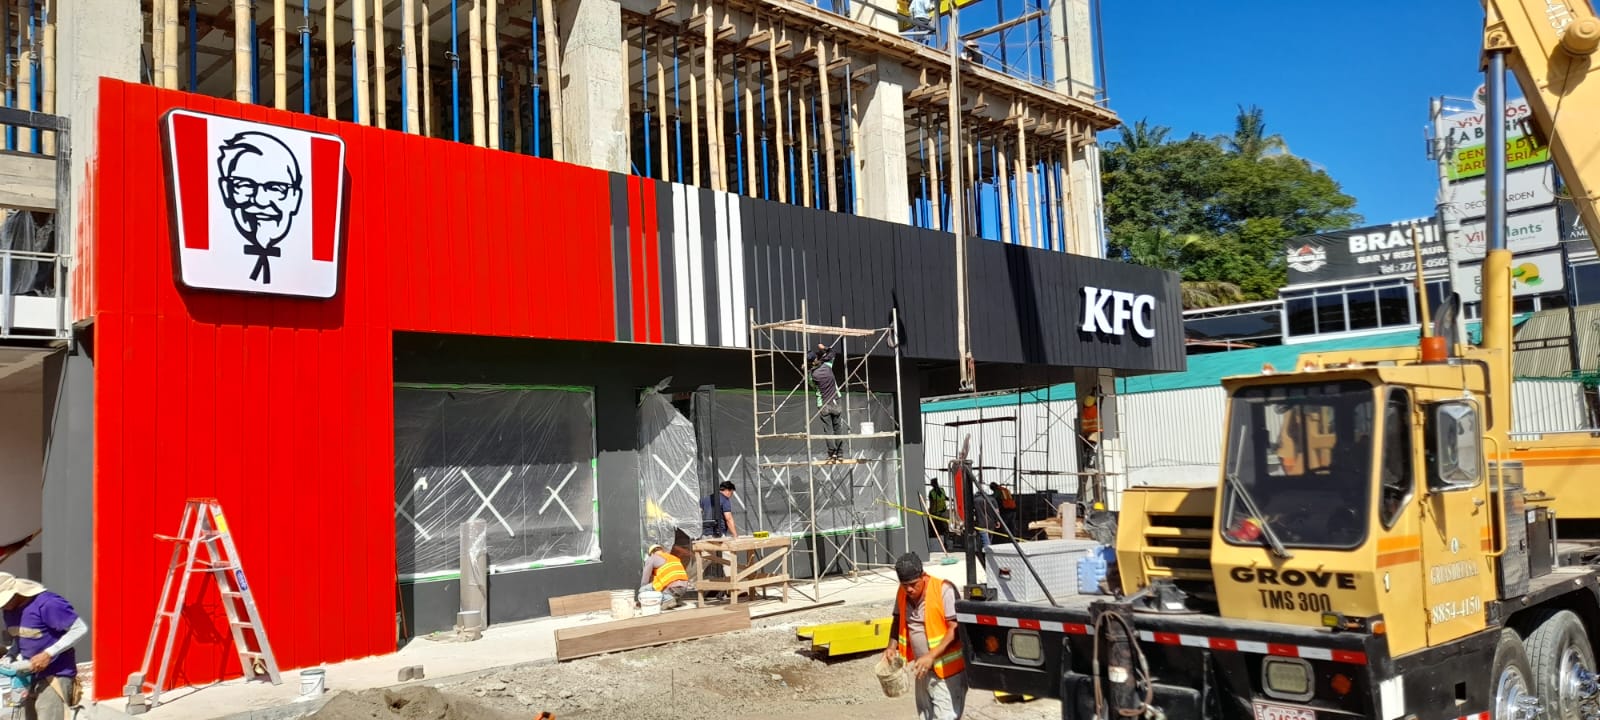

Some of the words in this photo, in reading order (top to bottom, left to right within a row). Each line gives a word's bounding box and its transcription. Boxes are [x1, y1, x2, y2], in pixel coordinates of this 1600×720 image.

[1458, 142, 1512, 161] CENO
[1357, 254, 1381, 264] BAR
[1382, 253, 1391, 261] Y
[1392, 246, 1446, 259] RESAUR
[1082, 286, 1155, 338] KFC
[1230, 566, 1357, 590] GROVE
[1383, 571, 1391, 593] 1
[1258, 589, 1295, 611] TMS
[1298, 592, 1332, 613] 300
[1432, 596, 1481, 625] 8854-4150
